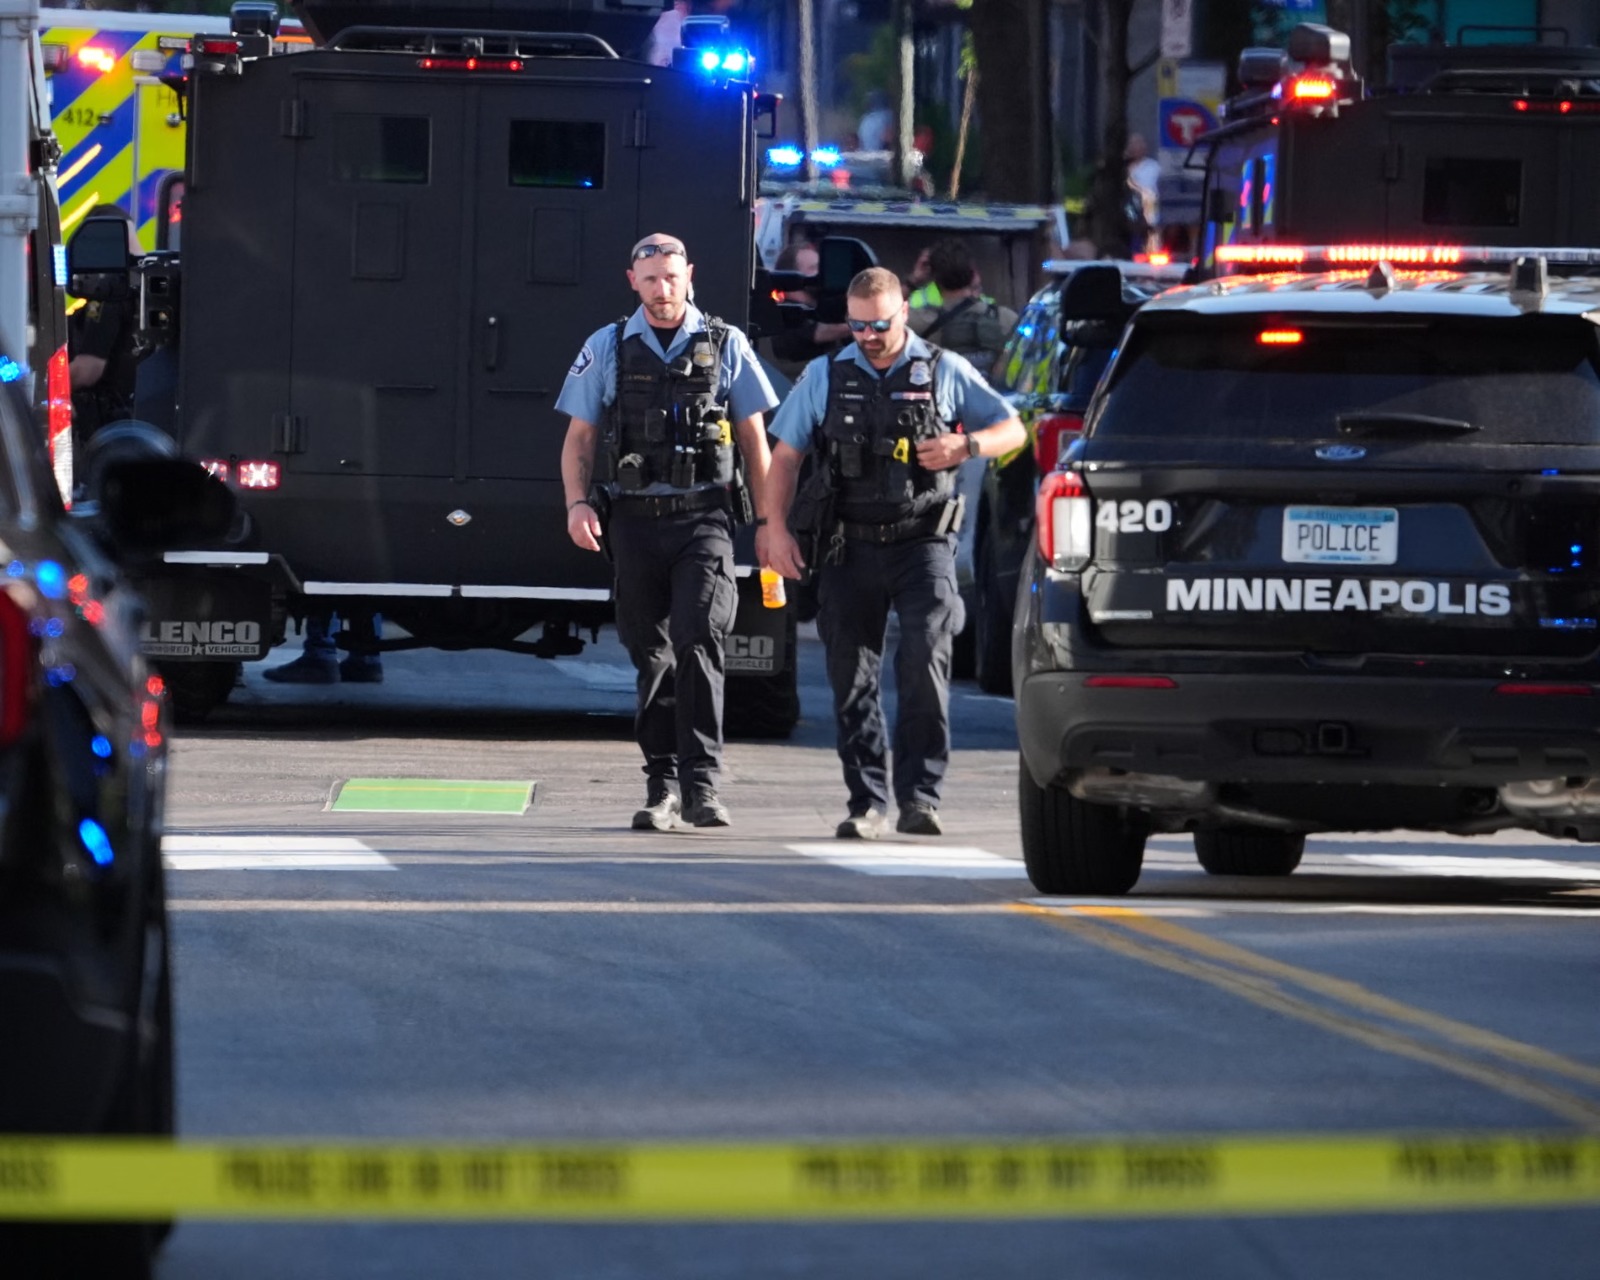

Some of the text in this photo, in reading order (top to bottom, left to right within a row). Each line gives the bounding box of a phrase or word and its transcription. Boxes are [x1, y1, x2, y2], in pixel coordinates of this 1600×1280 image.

[62, 107, 95, 127] 412
[1170, 115, 1201, 142] T
[1095, 499, 1172, 533] 420
[1297, 523, 1382, 551] POLICE
[1166, 578, 1512, 616] MINNEAPOLIS
[140, 620, 261, 644] LENCO
[207, 645, 257, 655] VEHICLES
